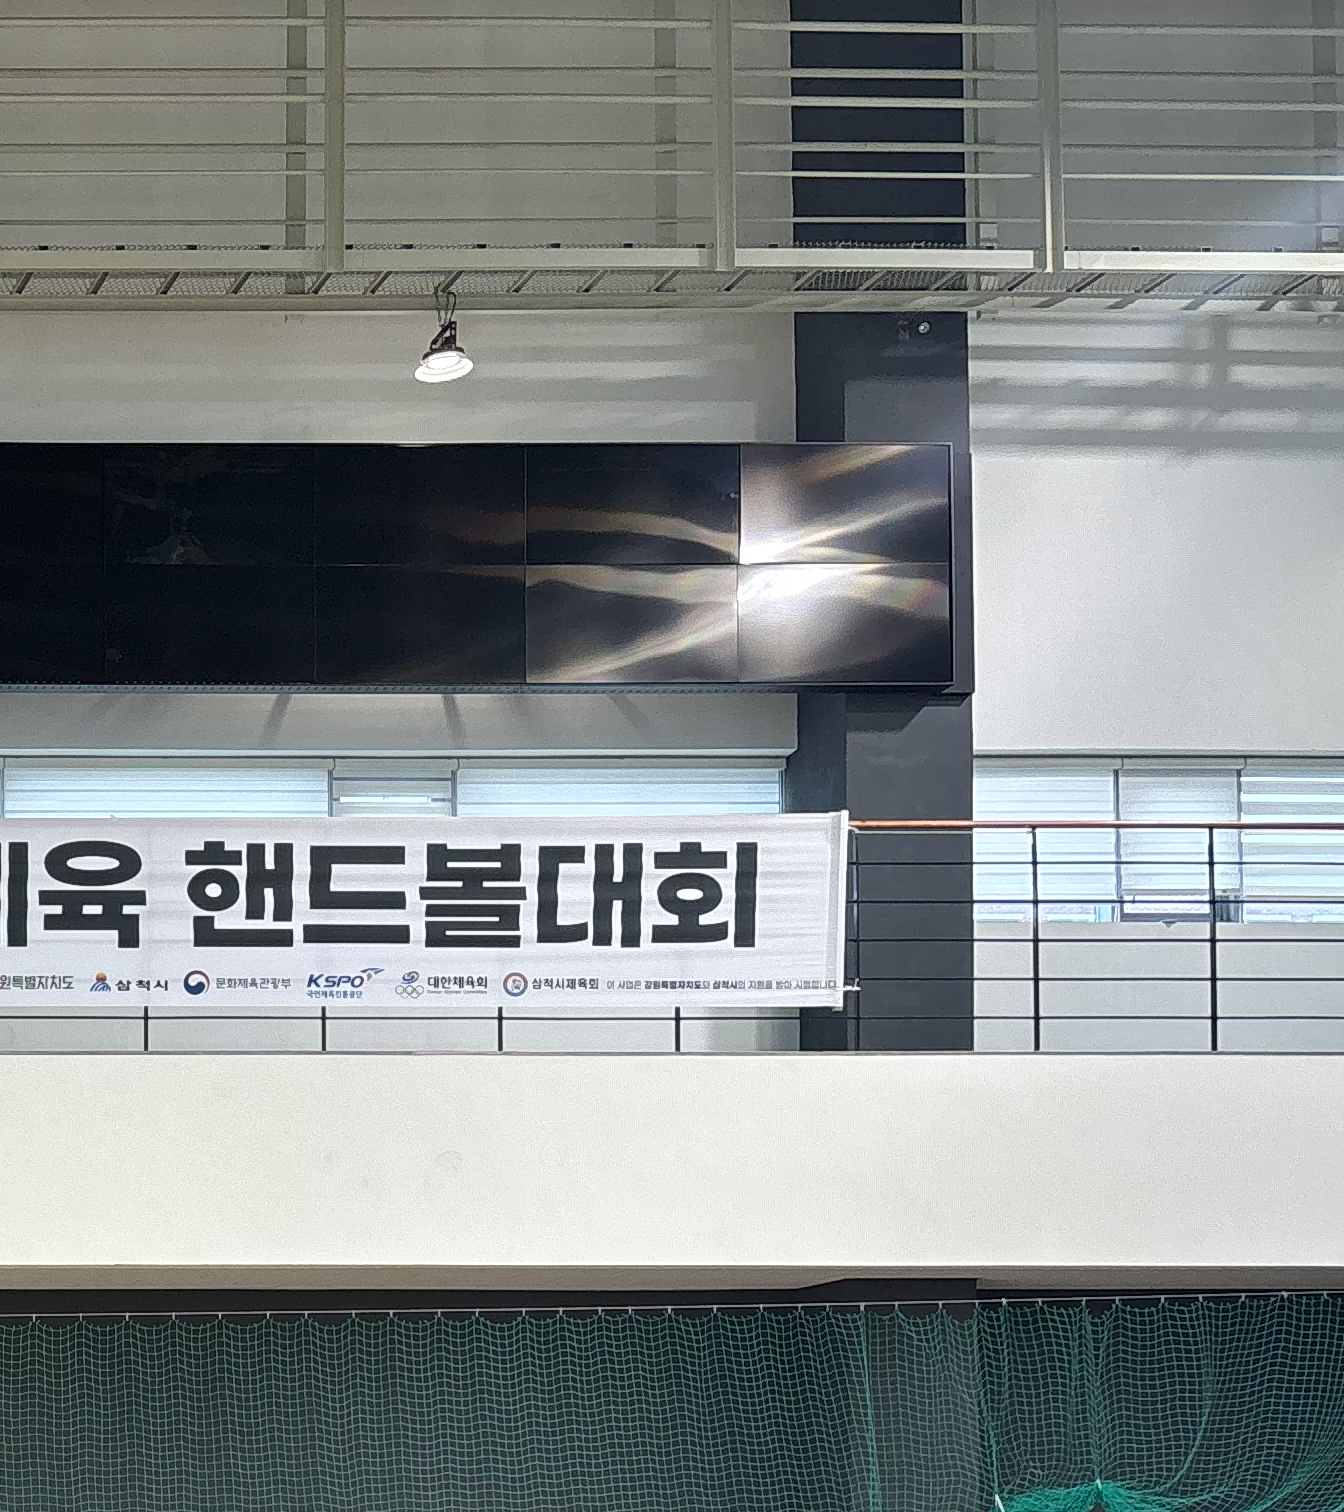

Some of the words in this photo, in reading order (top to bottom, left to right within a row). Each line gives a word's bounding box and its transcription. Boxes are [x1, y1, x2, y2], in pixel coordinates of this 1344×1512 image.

[186, 841, 759, 949] 핸드볼대회
[215, 976, 292, 989] 문화체육관광부
[307, 973, 365, 988] KSPO
[427, 975, 489, 989] 대한체육회
[531, 977, 600, 991] 삼척시체육회
